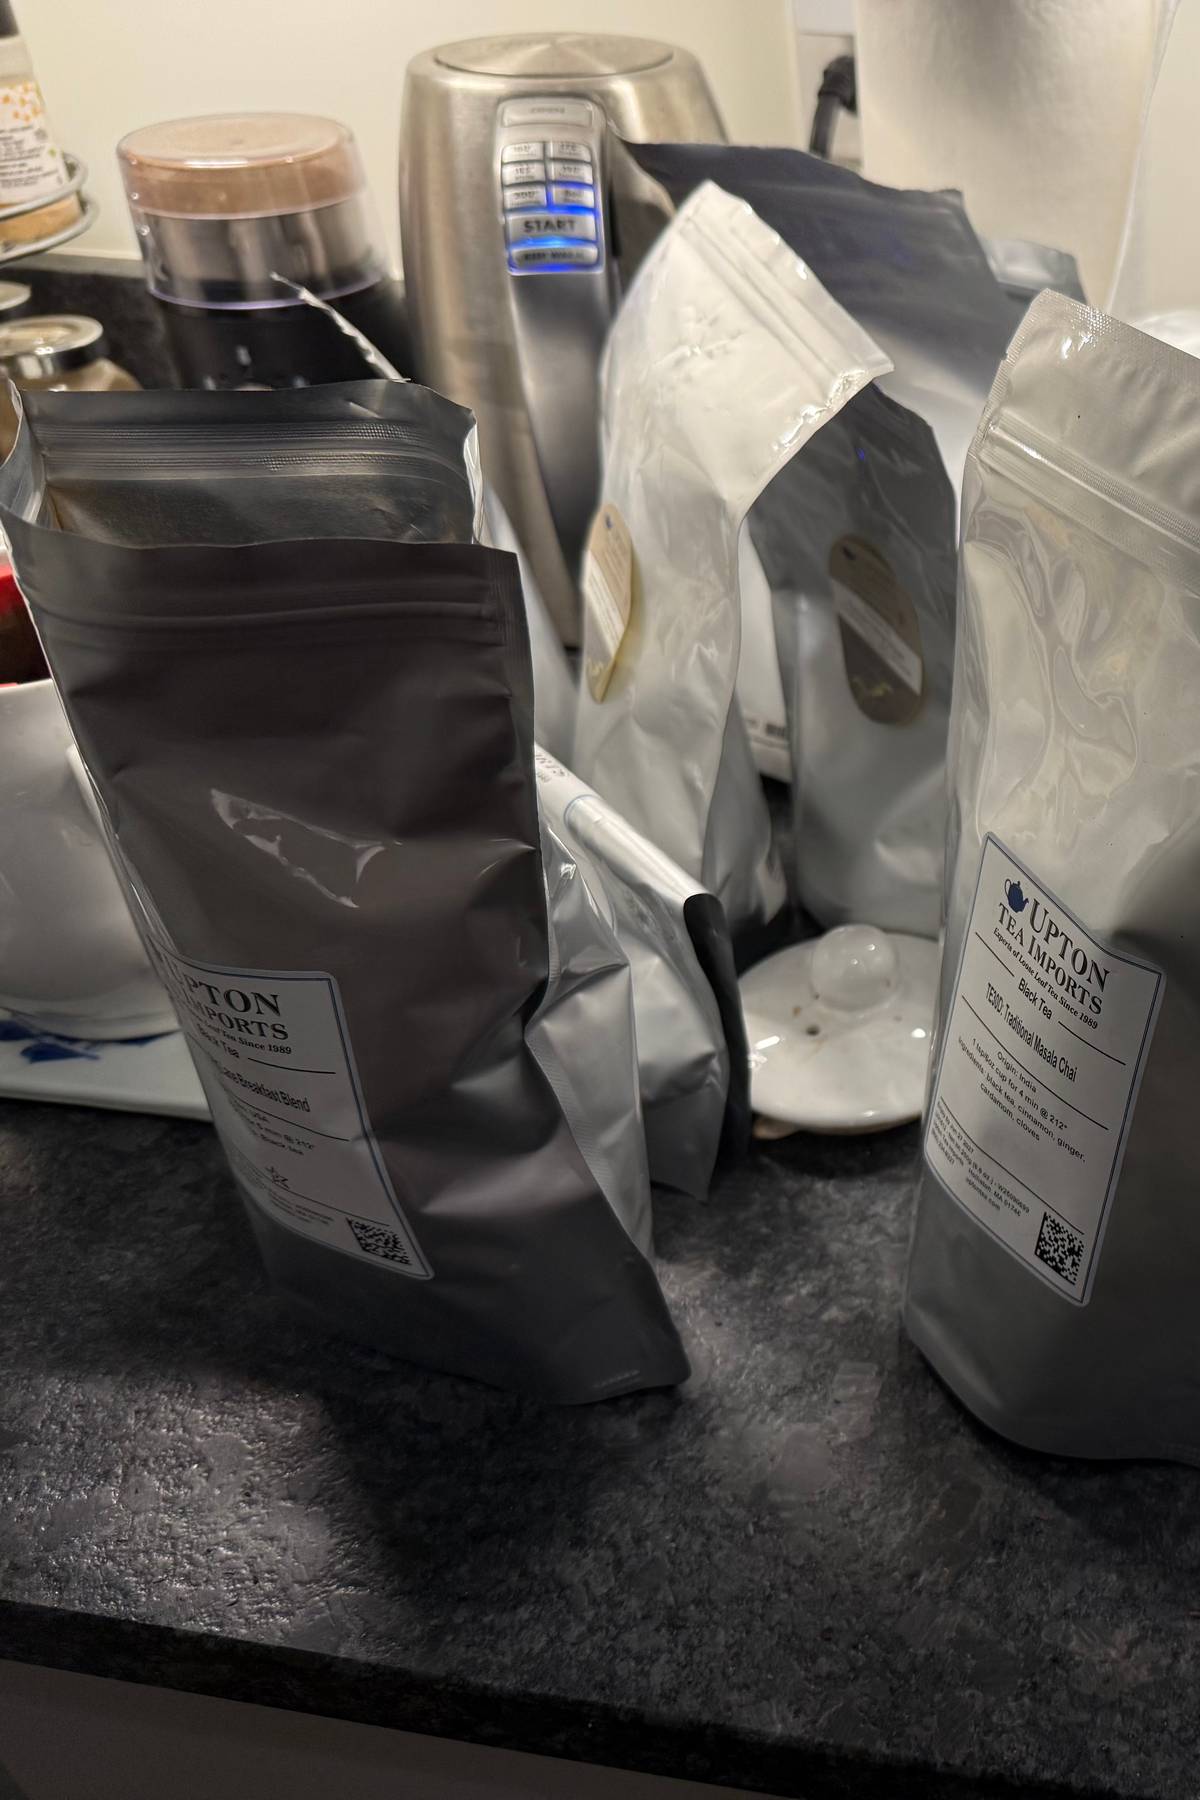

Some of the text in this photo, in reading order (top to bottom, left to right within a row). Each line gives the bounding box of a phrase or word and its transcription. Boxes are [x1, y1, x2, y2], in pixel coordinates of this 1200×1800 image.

[523, 219, 576, 234] START
[998, 902, 1103, 1015] TEA IMPORTS
[1029, 898, 1110, 993] UPTON
[993, 927, 1098, 1030] Experts of Loose Leaf Tea Since 1989
[1018, 977, 1053, 1020] Black Tea
[221, 1041, 240, 1059] Tea
[238, 1035, 266, 1051] Since
[267, 1043, 292, 1055] 1989
[1003, 1003, 1036, 1048] Traditional
[1033, 1035, 1058, 1069] Masala
[1058, 1057, 1078, 1083] Chai
[995, 1067, 1007, 1083] cup
[1007, 1077, 1019, 1092] for
[1024, 1095, 1039, 1111] min
[1039, 1107, 1049, 1120] @
[997, 1051, 1037, 1093] Origin: India
[279, 1089, 311, 1113] Blend
[980, 1082, 1016, 1121] cardamom,
[1016, 1117, 1041, 1141] cloves
[986, 1072, 1003, 1094] black
[1017, 1104, 1056, 1141] cinnamon,
